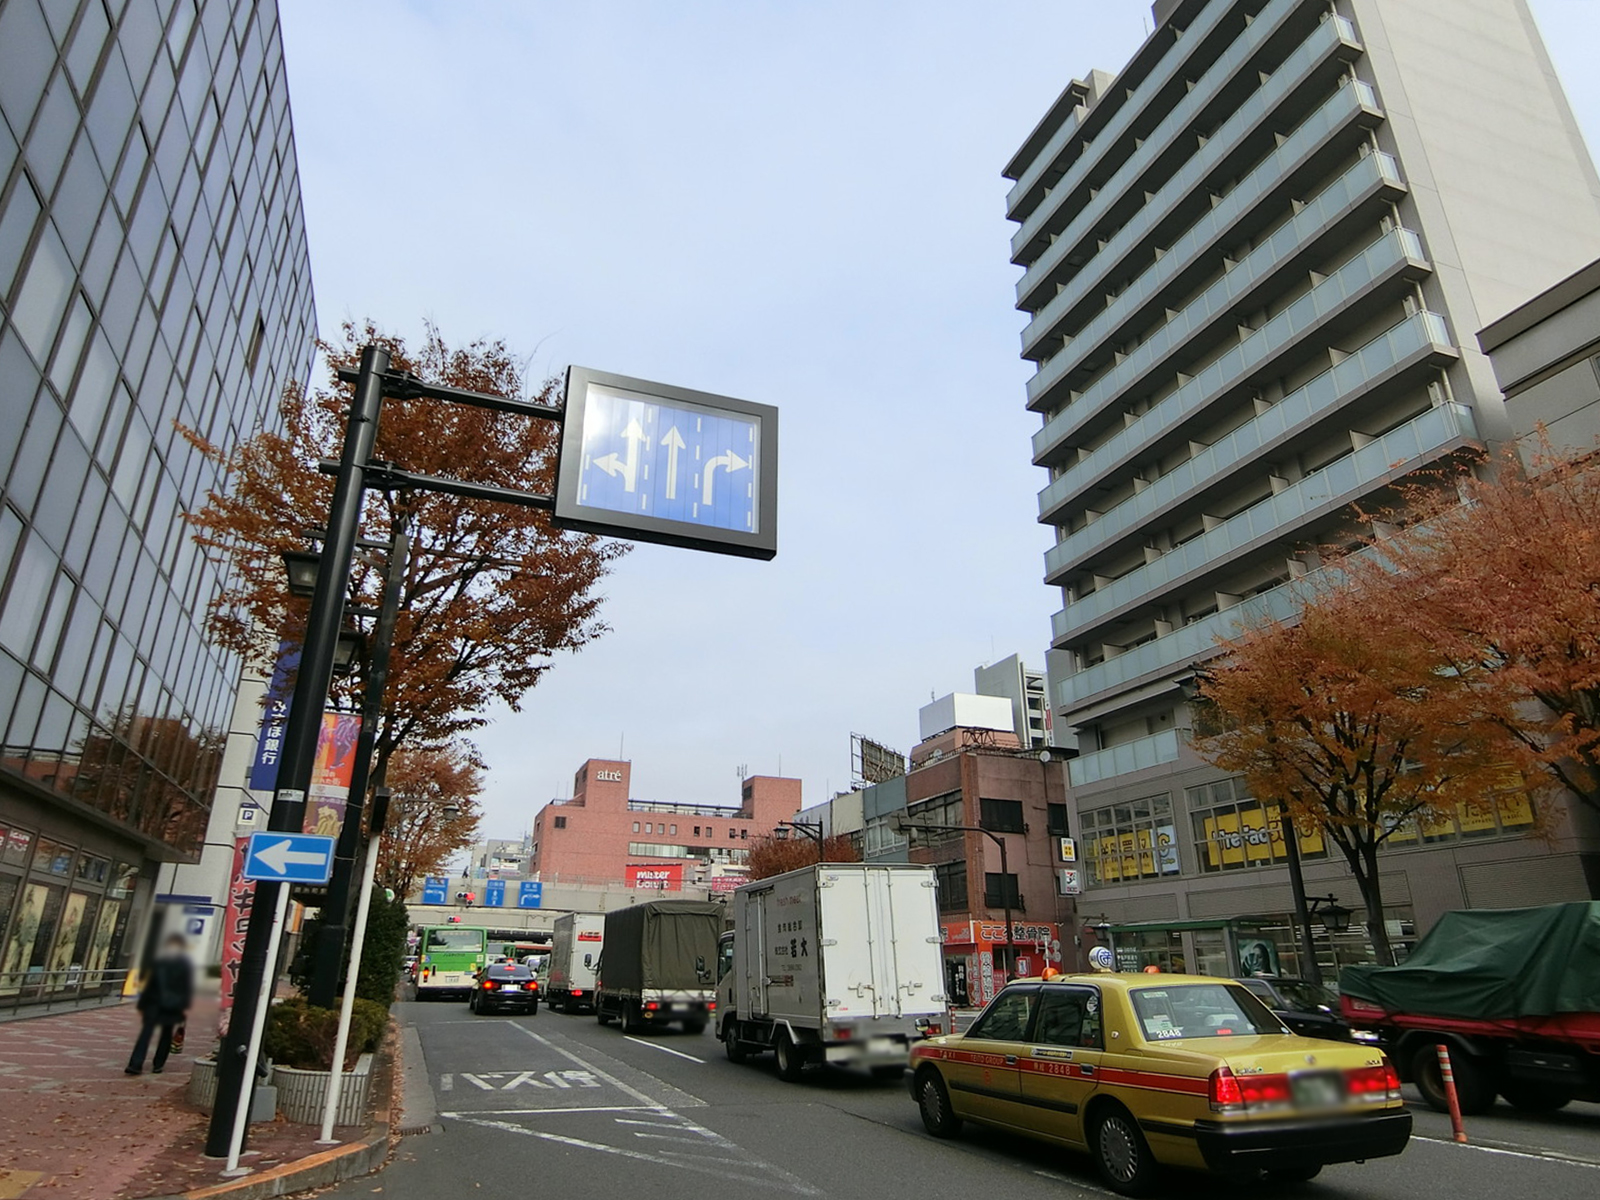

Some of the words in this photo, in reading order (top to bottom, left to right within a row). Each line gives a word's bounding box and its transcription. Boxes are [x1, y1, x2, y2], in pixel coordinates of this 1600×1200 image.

[261, 700, 287, 765] みずほ銀行
[1156, 1029, 1182, 1039] 2848
[939, 1050, 956, 1059] TAXI
[1049, 1064, 1071, 1075] 2848
